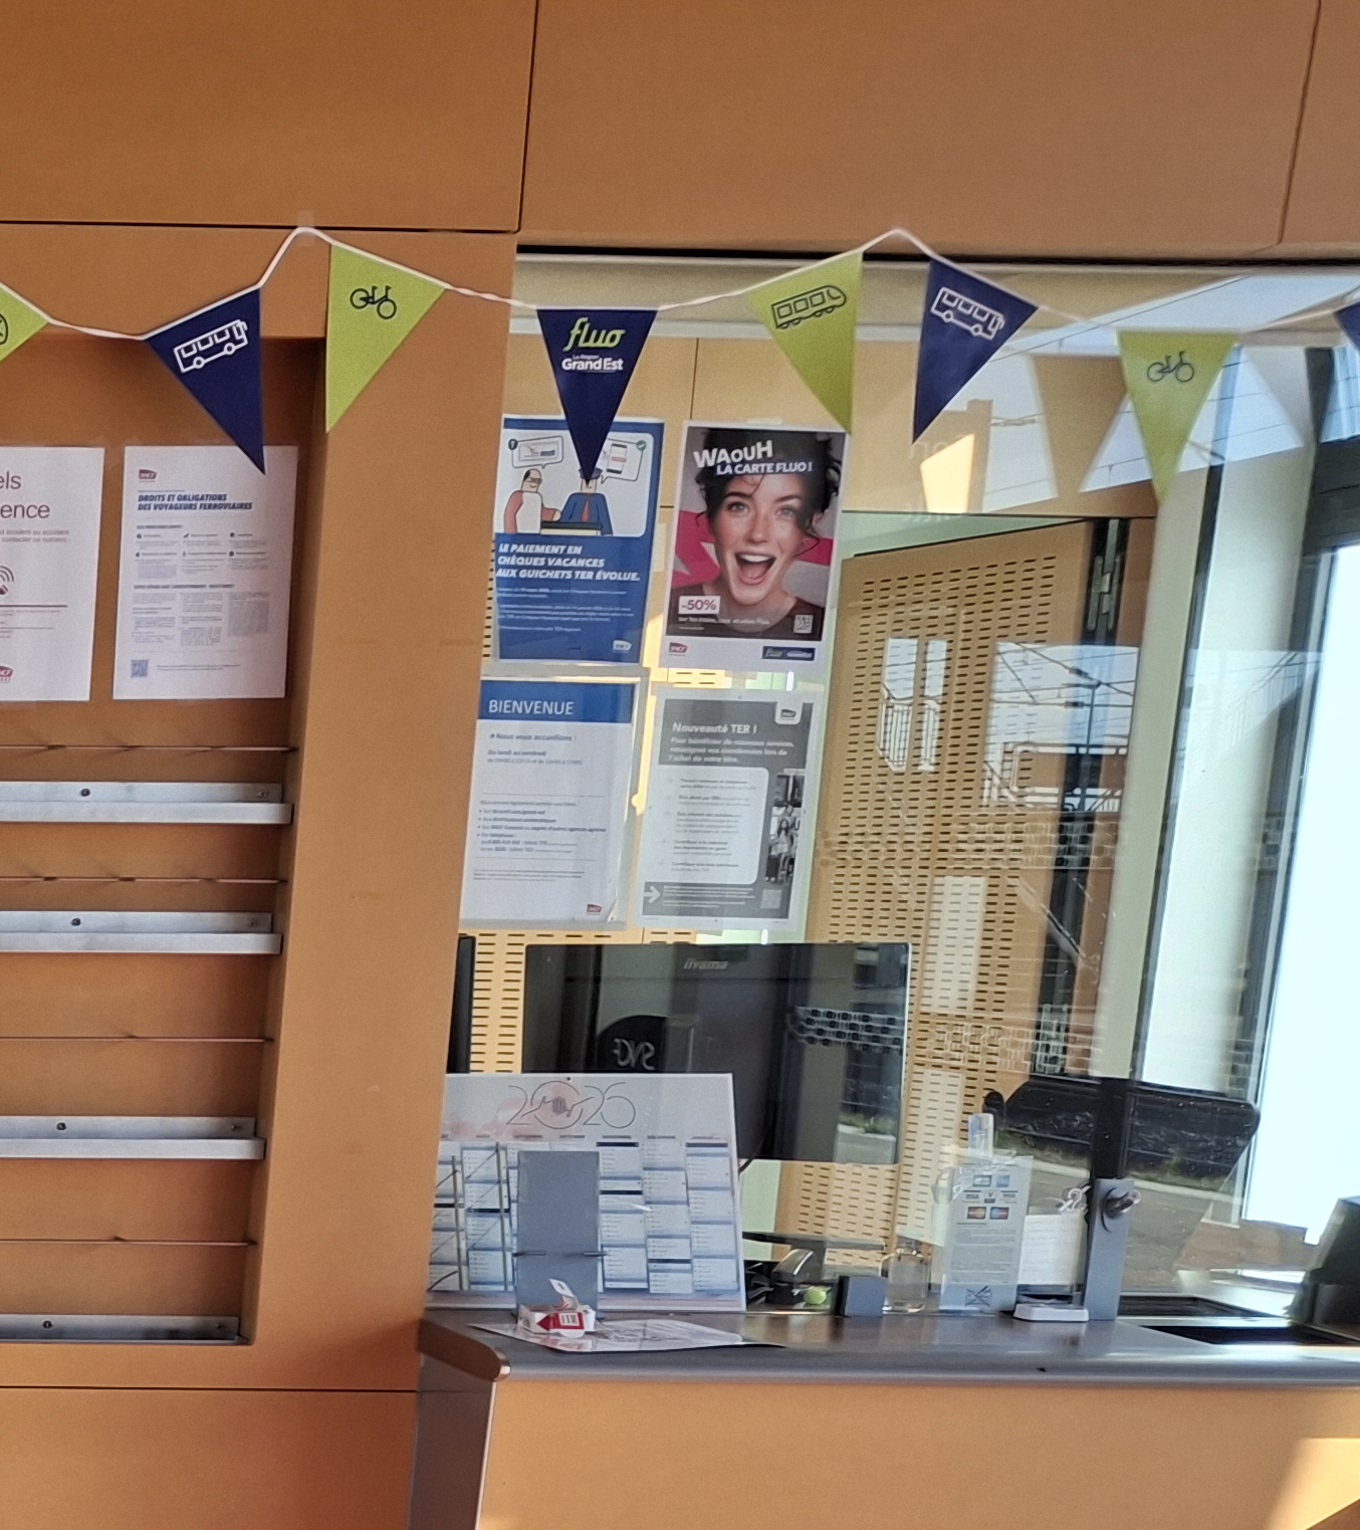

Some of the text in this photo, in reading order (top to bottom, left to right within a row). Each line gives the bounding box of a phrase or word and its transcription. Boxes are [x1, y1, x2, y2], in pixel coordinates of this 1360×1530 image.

[563, 317, 626, 352] fluo
[717, 462, 732, 474] LA
[734, 463, 774, 473] CARTE
[199, 502, 253, 510] FERROVIAIRES
[499, 544, 582, 554] LE PAIEMENT EN
[498, 556, 605, 567] CHÈQUES VACANCES
[496, 569, 640, 581] AUX GUICHETS TER ÉVOLUE.
[681, 600, 716, 610] -50%
[489, 700, 574, 715] BIENVENUE
[673, 722, 750, 734] Nouveauté TER
